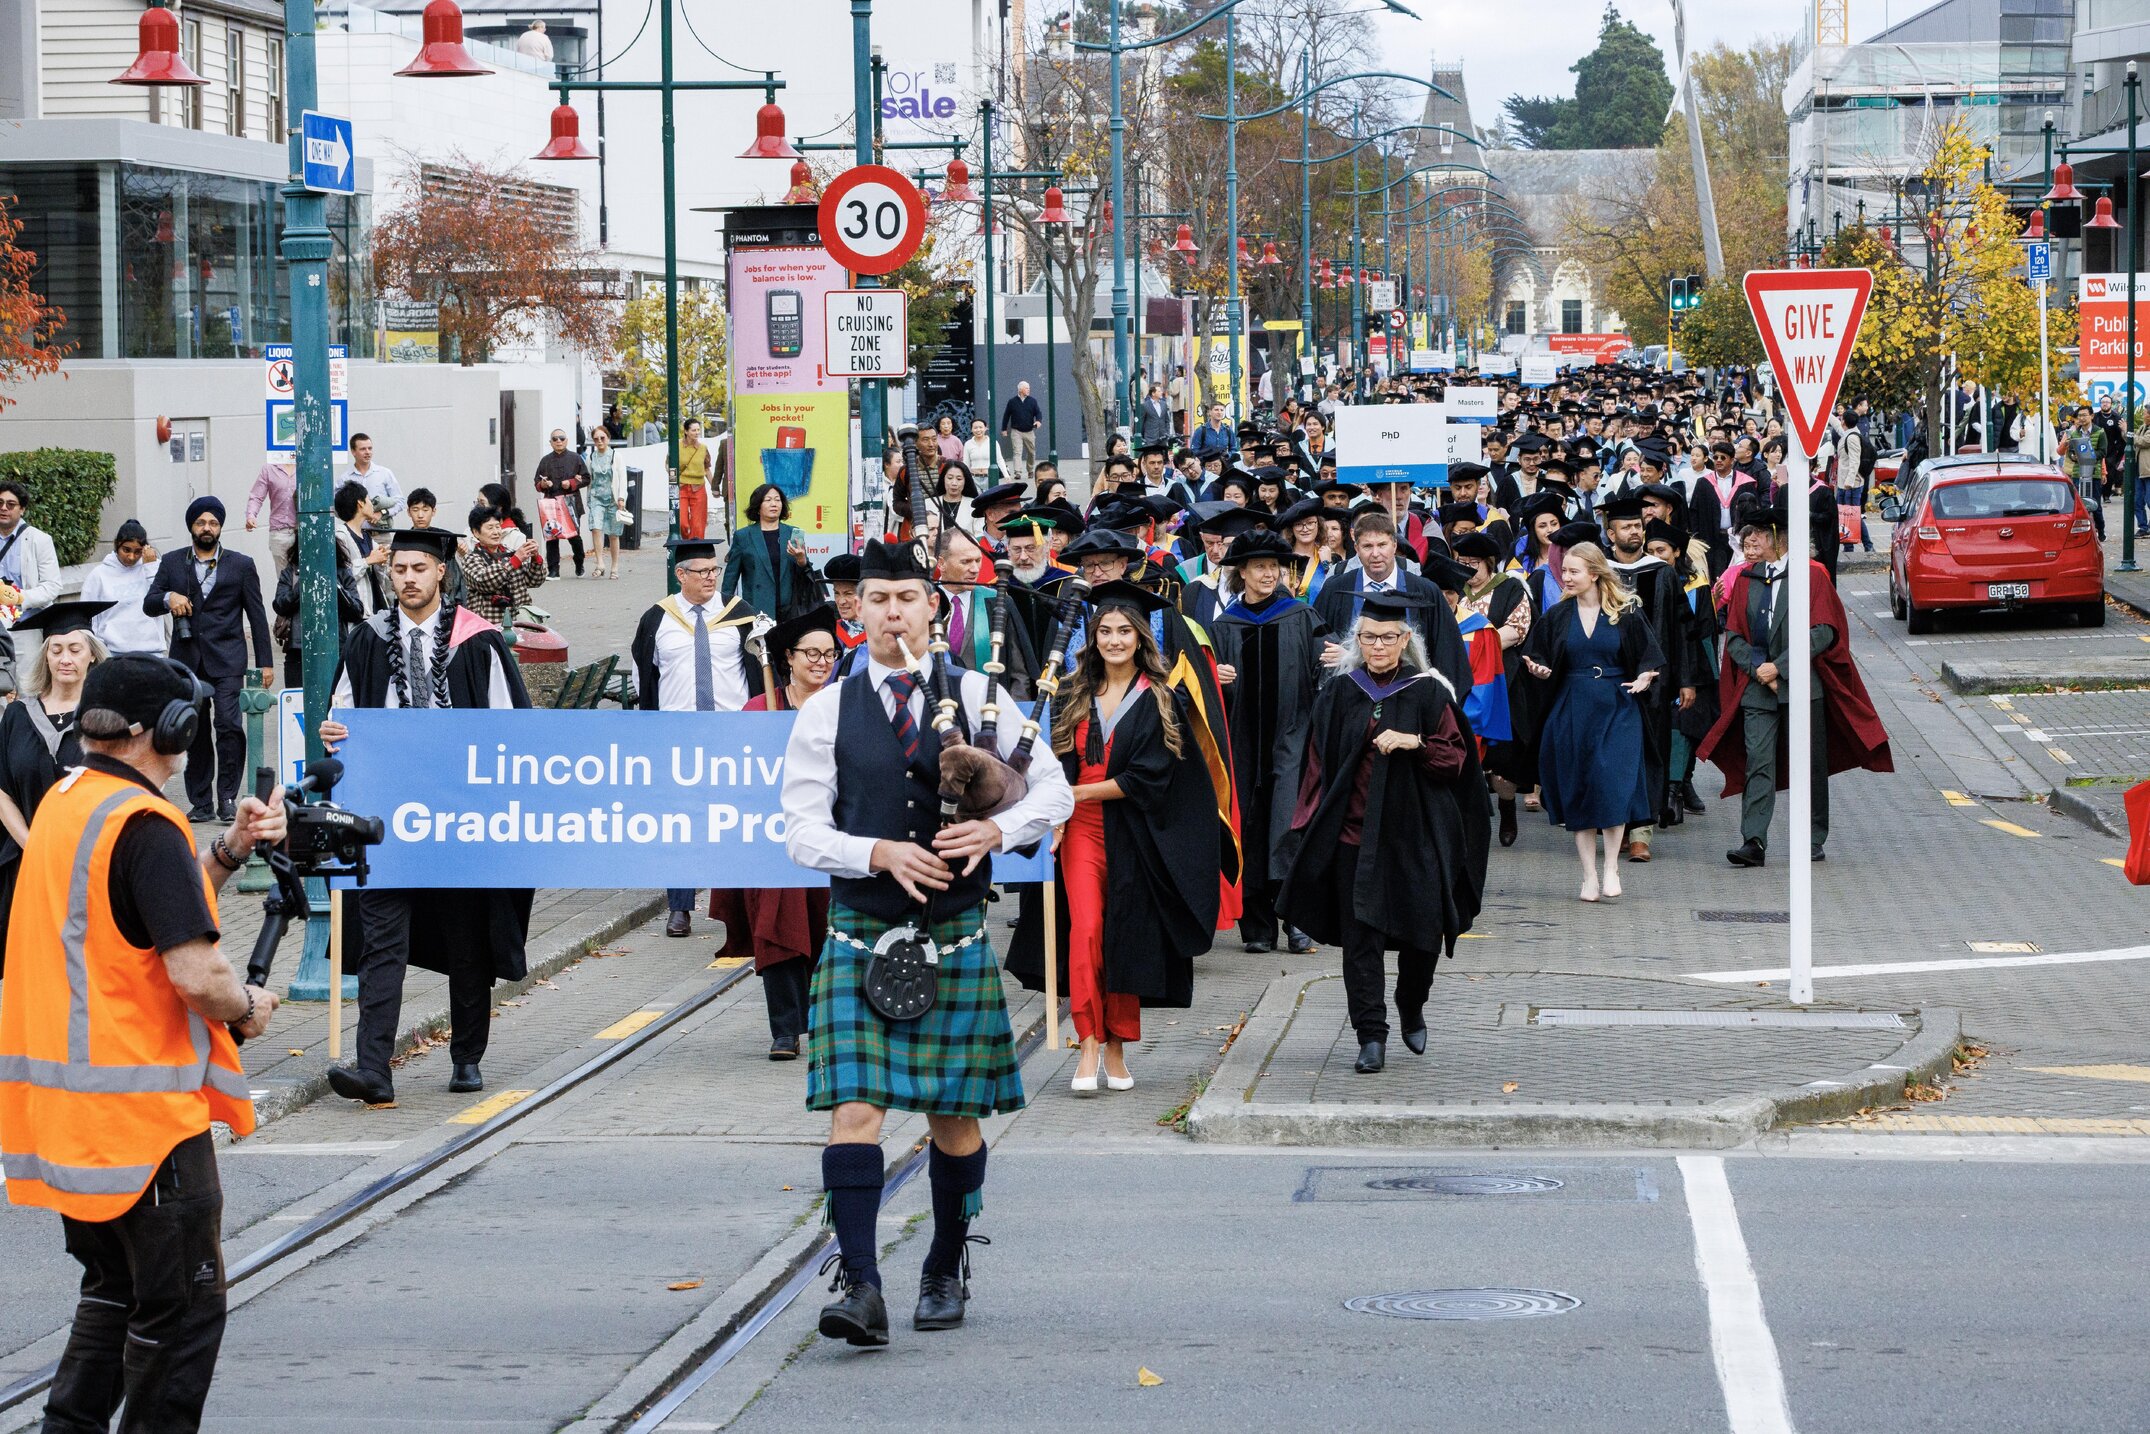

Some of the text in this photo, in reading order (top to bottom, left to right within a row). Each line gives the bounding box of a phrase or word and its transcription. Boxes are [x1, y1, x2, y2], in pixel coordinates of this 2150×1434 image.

[881, 72, 925, 94] or
[882, 88, 957, 119] sale
[311, 141, 334, 162] ONE WAY
[844, 199, 901, 240] 30
[2035, 256, 2045, 264] 120
[806, 264, 826, 272] your
[752, 275, 784, 283] balance
[857, 296, 873, 312] NO
[838, 316, 893, 331] CRUISING
[1785, 304, 1834, 340] GIVE
[851, 335, 881, 351] ZONE
[2090, 339, 2143, 357] Parkig
[268, 347, 345, 358] LIQUO ONE
[1211, 350, 1231, 366] agl
[851, 355, 881, 371] ENDS
[1795, 355, 1826, 384] WAY
[774, 370, 792, 378] app!
[2095, 386, 2110, 404] P
[760, 404, 781, 412] Jobs
[794, 405, 815, 413] your
[770, 414, 804, 423] pocket!
[1381, 431, 1400, 439] PhD
[1447, 434, 1457, 443] of
[2080, 444, 2086, 452] P
[1447, 456, 1462, 464] ing
[807, 546, 829, 554] lm of
[1990, 585, 2028, 596] GR50
[467, 743, 784, 787] Lincoln Univ
[326, 812, 354, 825] RONIN
[392, 800, 787, 844] Graduation Pro
